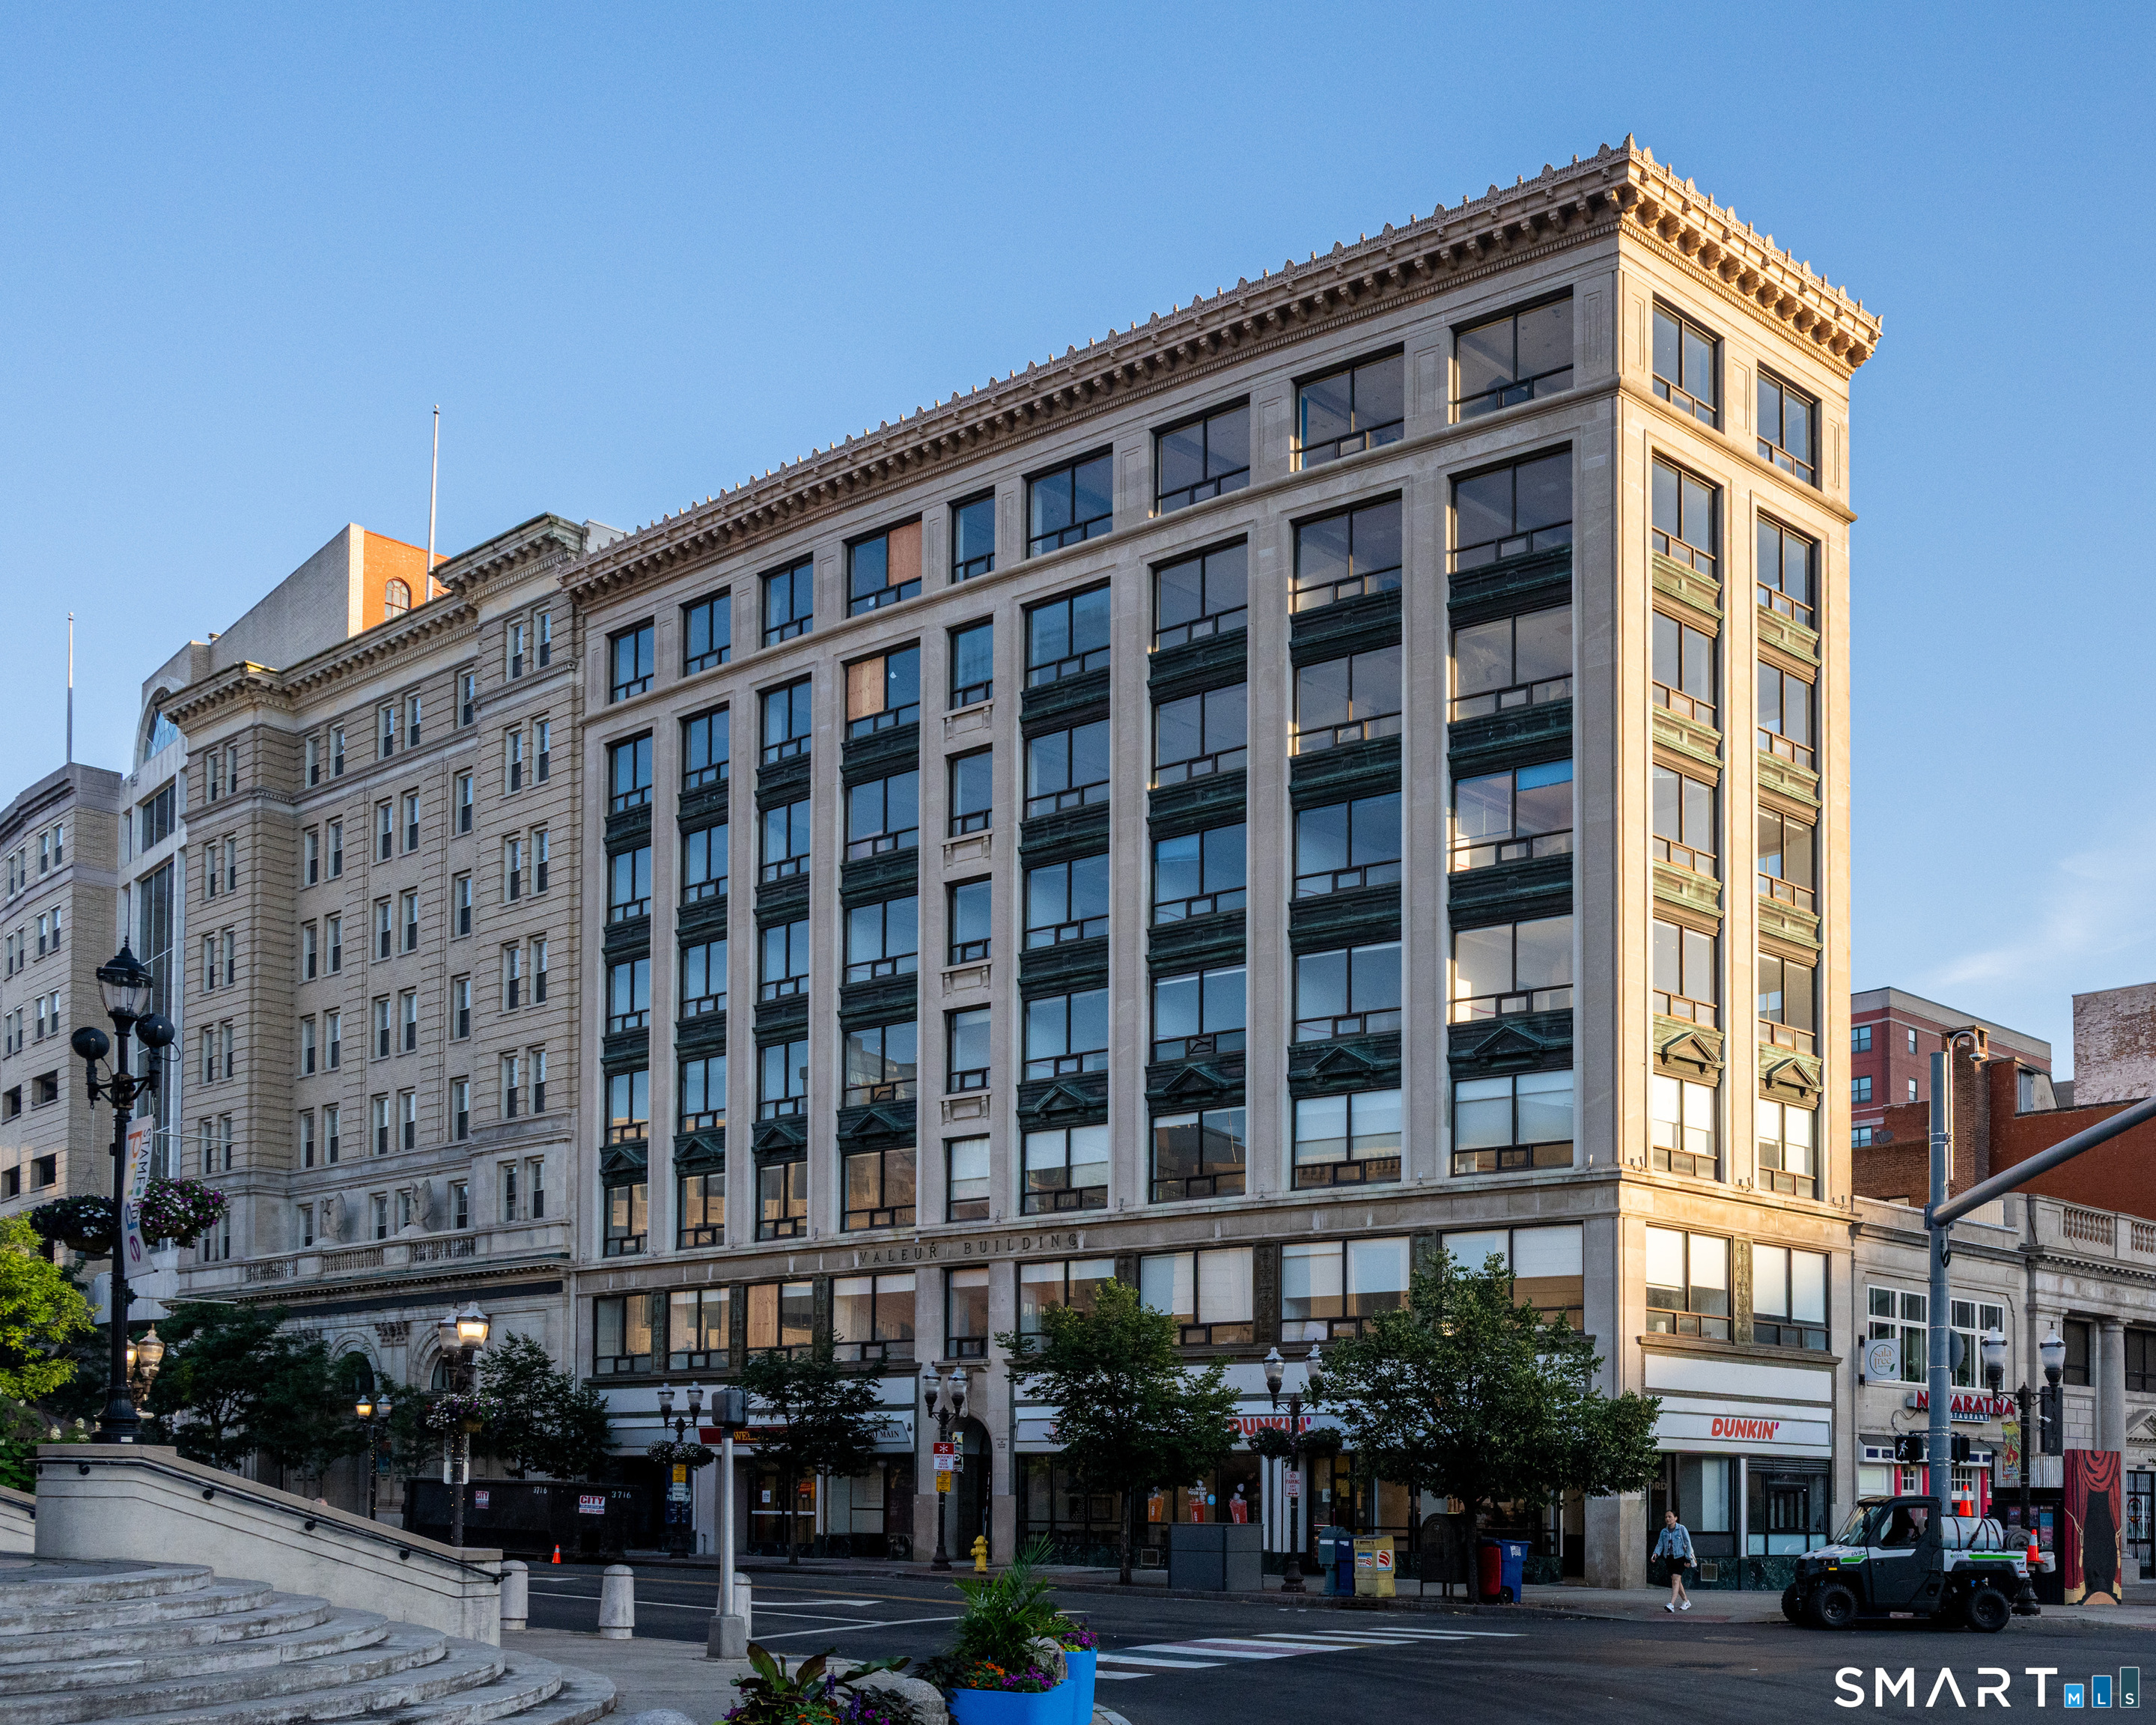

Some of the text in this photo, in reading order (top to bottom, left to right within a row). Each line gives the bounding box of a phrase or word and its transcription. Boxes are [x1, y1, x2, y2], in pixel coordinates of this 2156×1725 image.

[964, 1234, 1077, 1255] BUILDING
[1917, 1390, 2015, 1416] NARATNA
[1950, 1412, 1988, 1421] STAURANT
[1711, 1418, 1779, 1440] DUNKIN'
[533, 1486, 547, 1494] 3716
[476, 1491, 488, 1500] CITY
[612, 1491, 632, 1499] 3716
[580, 1496, 603, 1505] CITY
